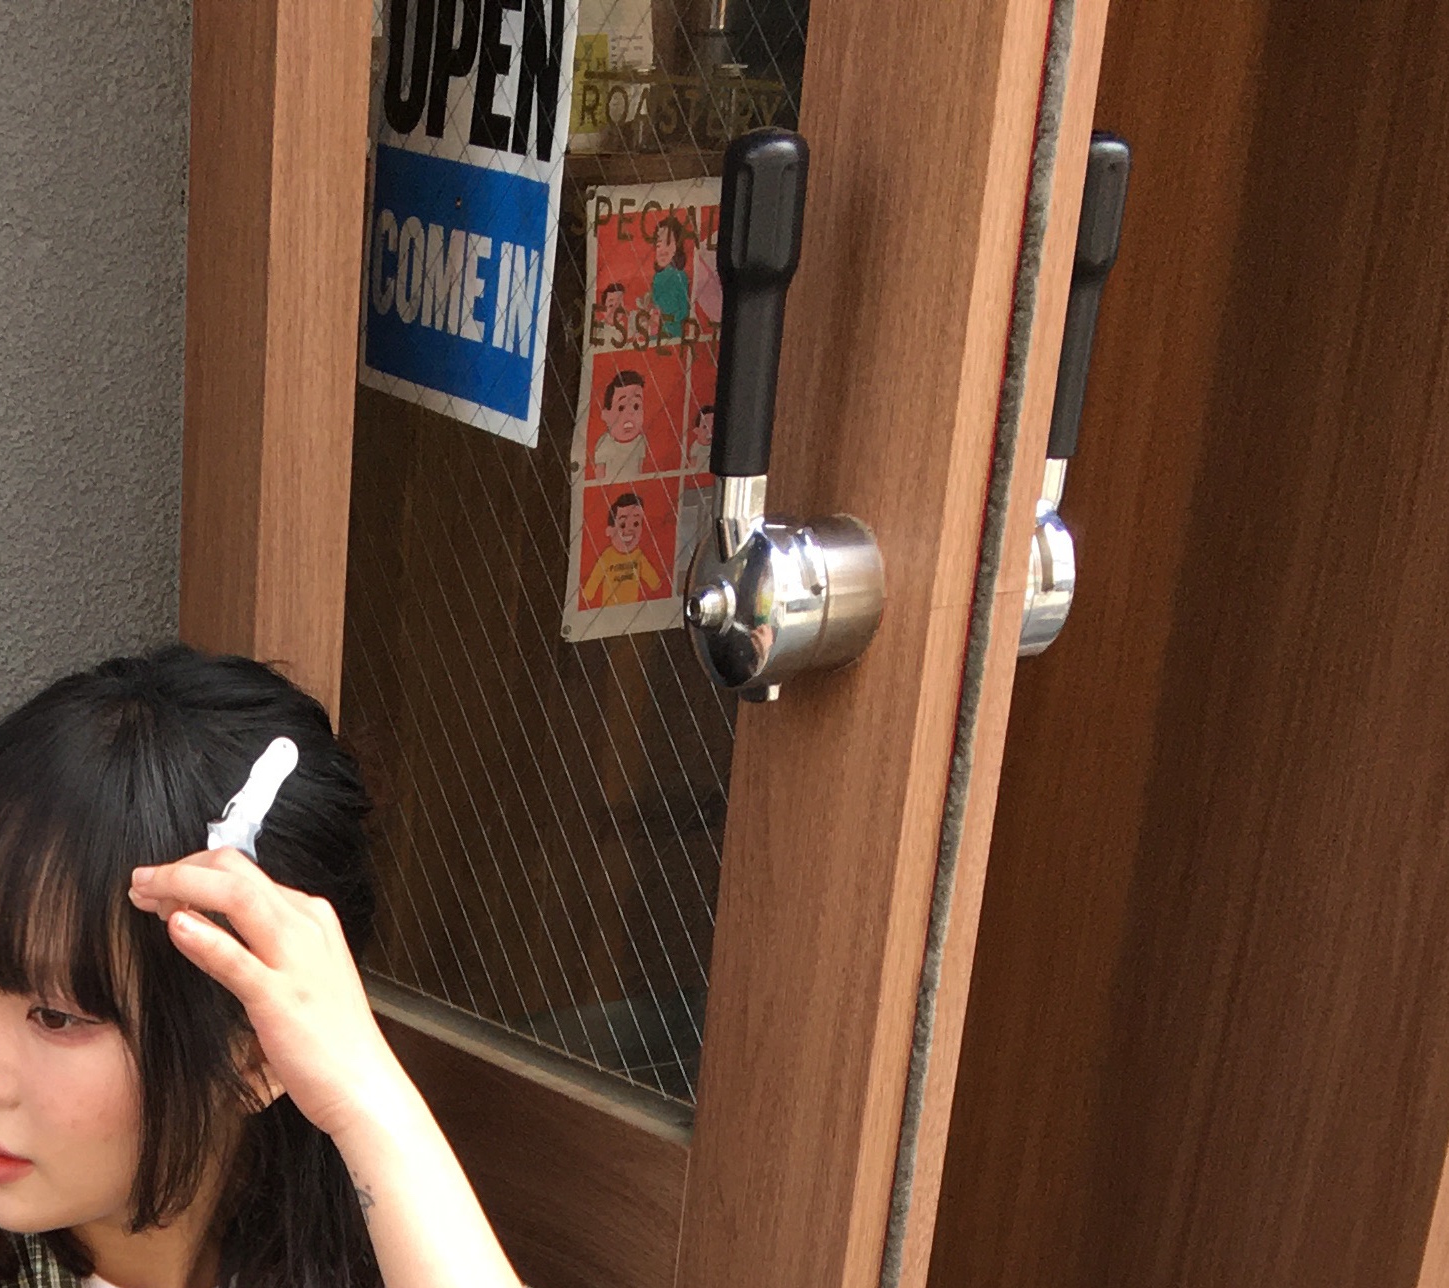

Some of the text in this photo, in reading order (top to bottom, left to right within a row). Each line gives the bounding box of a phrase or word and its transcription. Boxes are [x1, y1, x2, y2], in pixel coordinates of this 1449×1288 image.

[383, 0, 565, 163] OPEN
[371, 209, 540, 359] COME IN
